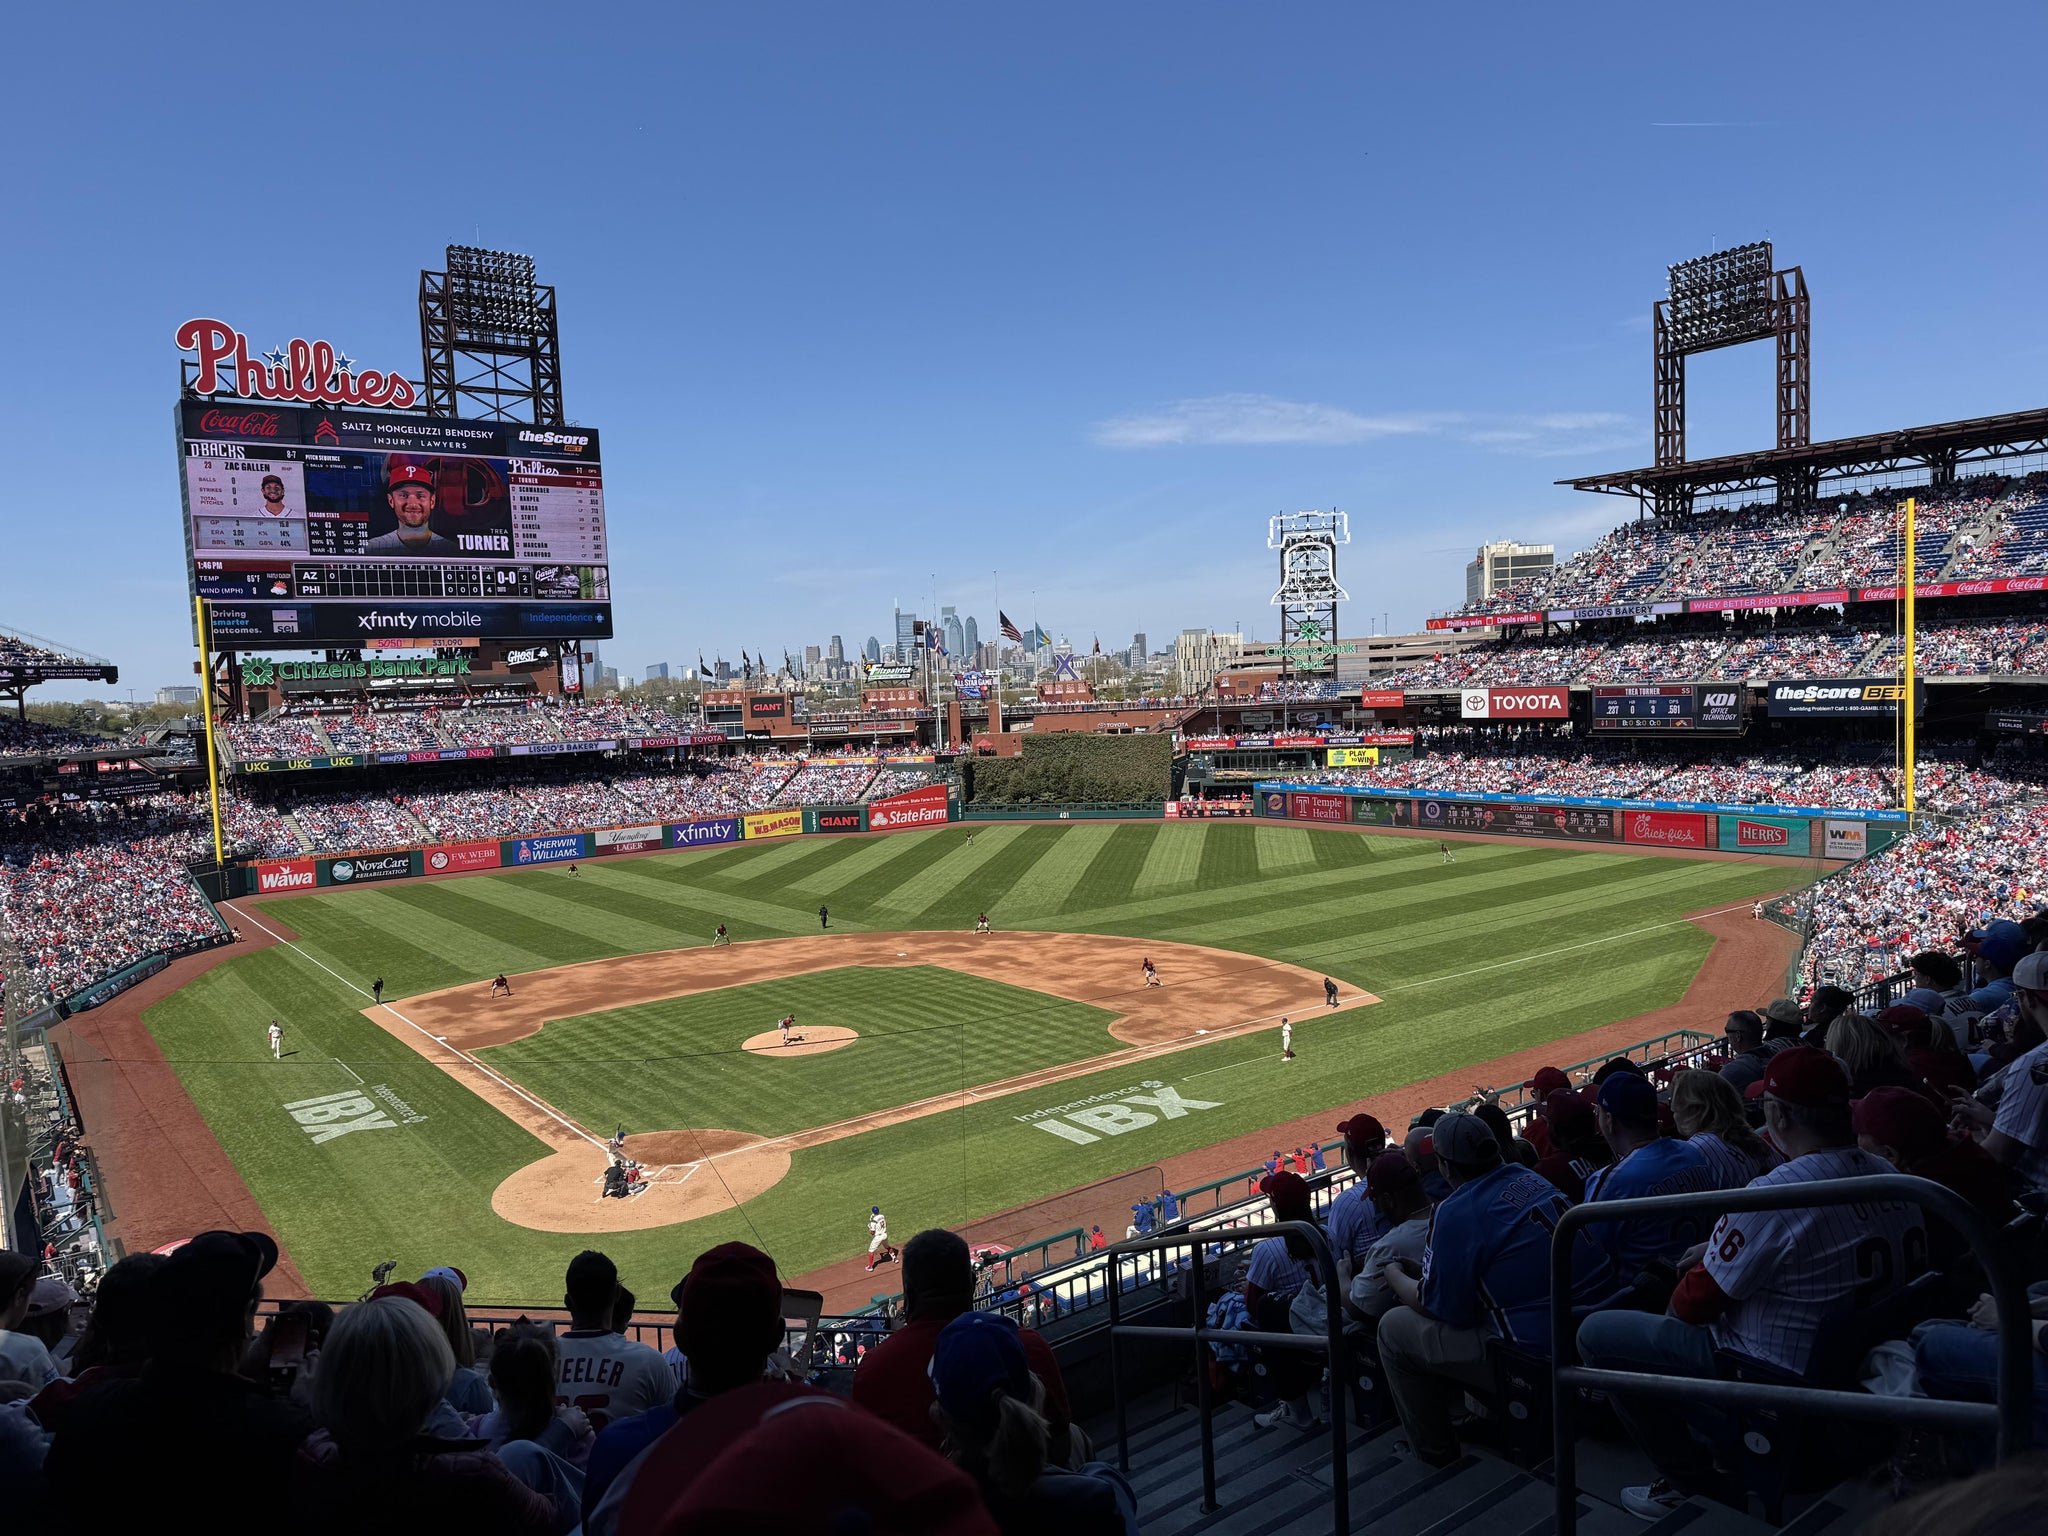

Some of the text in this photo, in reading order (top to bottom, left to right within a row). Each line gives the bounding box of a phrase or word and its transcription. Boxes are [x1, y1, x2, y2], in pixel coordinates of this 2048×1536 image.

[175, 318, 417, 409] Phillies
[201, 409, 281, 436] Coca-Cola
[342, 422, 494, 439] SALTZ MONGELUZZI BENDESKY
[373, 437, 467, 449] INJURY LAWYERS
[518, 430, 589, 445] theScore
[286, 450, 296, 459] 8-7
[204, 461, 270, 472] 23 ZAC GALLEN
[508, 459, 559, 475] Phillies
[457, 534, 510, 551] TURNER
[303, 572, 318, 580] AZ
[497, 571, 516, 584] 0-0
[302, 586, 320, 594] PHI
[1864, 578, 2045, 600] Coca-Cola Coca-Cola Coca-Cola
[1693, 601, 1720, 610] WHEY
[1723, 599, 1756, 608] BETTER
[1758, 597, 1800, 606] PROTEIN
[212, 610, 247, 619] Driving
[1573, 605, 1654, 618] LISCIO'S BAKERY
[212, 618, 250, 626] smarter
[358, 611, 482, 630] xfinity mobile
[529, 613, 593, 624] Independence
[1446, 620, 1469, 628] Phillies
[1497, 616, 1516, 624] Deals
[432, 638, 463, 647] $31,090
[1265, 643, 1355, 657] Citizens Bank
[278, 656, 471, 680] Citizens Bank Park
[1296, 659, 1325, 670] Park
[978, 678, 994, 686] GAME
[1625, 687, 1638, 695] TREA
[1640, 687, 1660, 695] TURNER
[1775, 686, 1905, 700] theScore BET
[1493, 695, 1561, 710] TOYOTA
[1703, 694, 1737, 707] KDI
[753, 703, 782, 712] GIANT
[1630, 705, 1635, 714] 0
[1650, 705, 1656, 714] 3
[644, 735, 723, 746] TOYOTA TOYOTA
[528, 742, 599, 753] LISCIO'S BAKERY
[409, 752, 438, 761] NECA
[469, 749, 494, 758] NECA
[244, 757, 353, 772] UKG UKG UKG
[1312, 797, 1342, 808] Temple
[1313, 809, 1341, 819] Health
[1878, 812, 1901, 820] ibx.com
[820, 816, 859, 827] GIANT
[677, 822, 731, 843] xfinity
[1634, 814, 1695, 842] Chick-fil-A
[1742, 826, 1782, 841] HERR'S
[608, 831, 650, 843] Yuengling
[1830, 830, 1862, 840] WM
[405, 842, 444, 850] ASPLUNDH
[451, 838, 489, 846] ASPLUNDH
[533, 839, 576, 851] SHERWIN
[616, 842, 644, 851] LAGER
[309, 852, 350, 861] ASPLUNDH
[358, 847, 399, 856] ASPLUNDH
[451, 850, 496, 861] F.W. WEBB
[258, 857, 300, 865] ASPLUNDH
[354, 857, 409, 872] NovaCare
[262, 871, 313, 888] Wawa
[356, 869, 407, 879] REHABILITATION
[1013, 1085, 1141, 1123] Independence
[282, 1089, 398, 1145] IBX
[1032, 1086, 1225, 1145] IBX
[1501, 1174, 1546, 1210] ROSE
